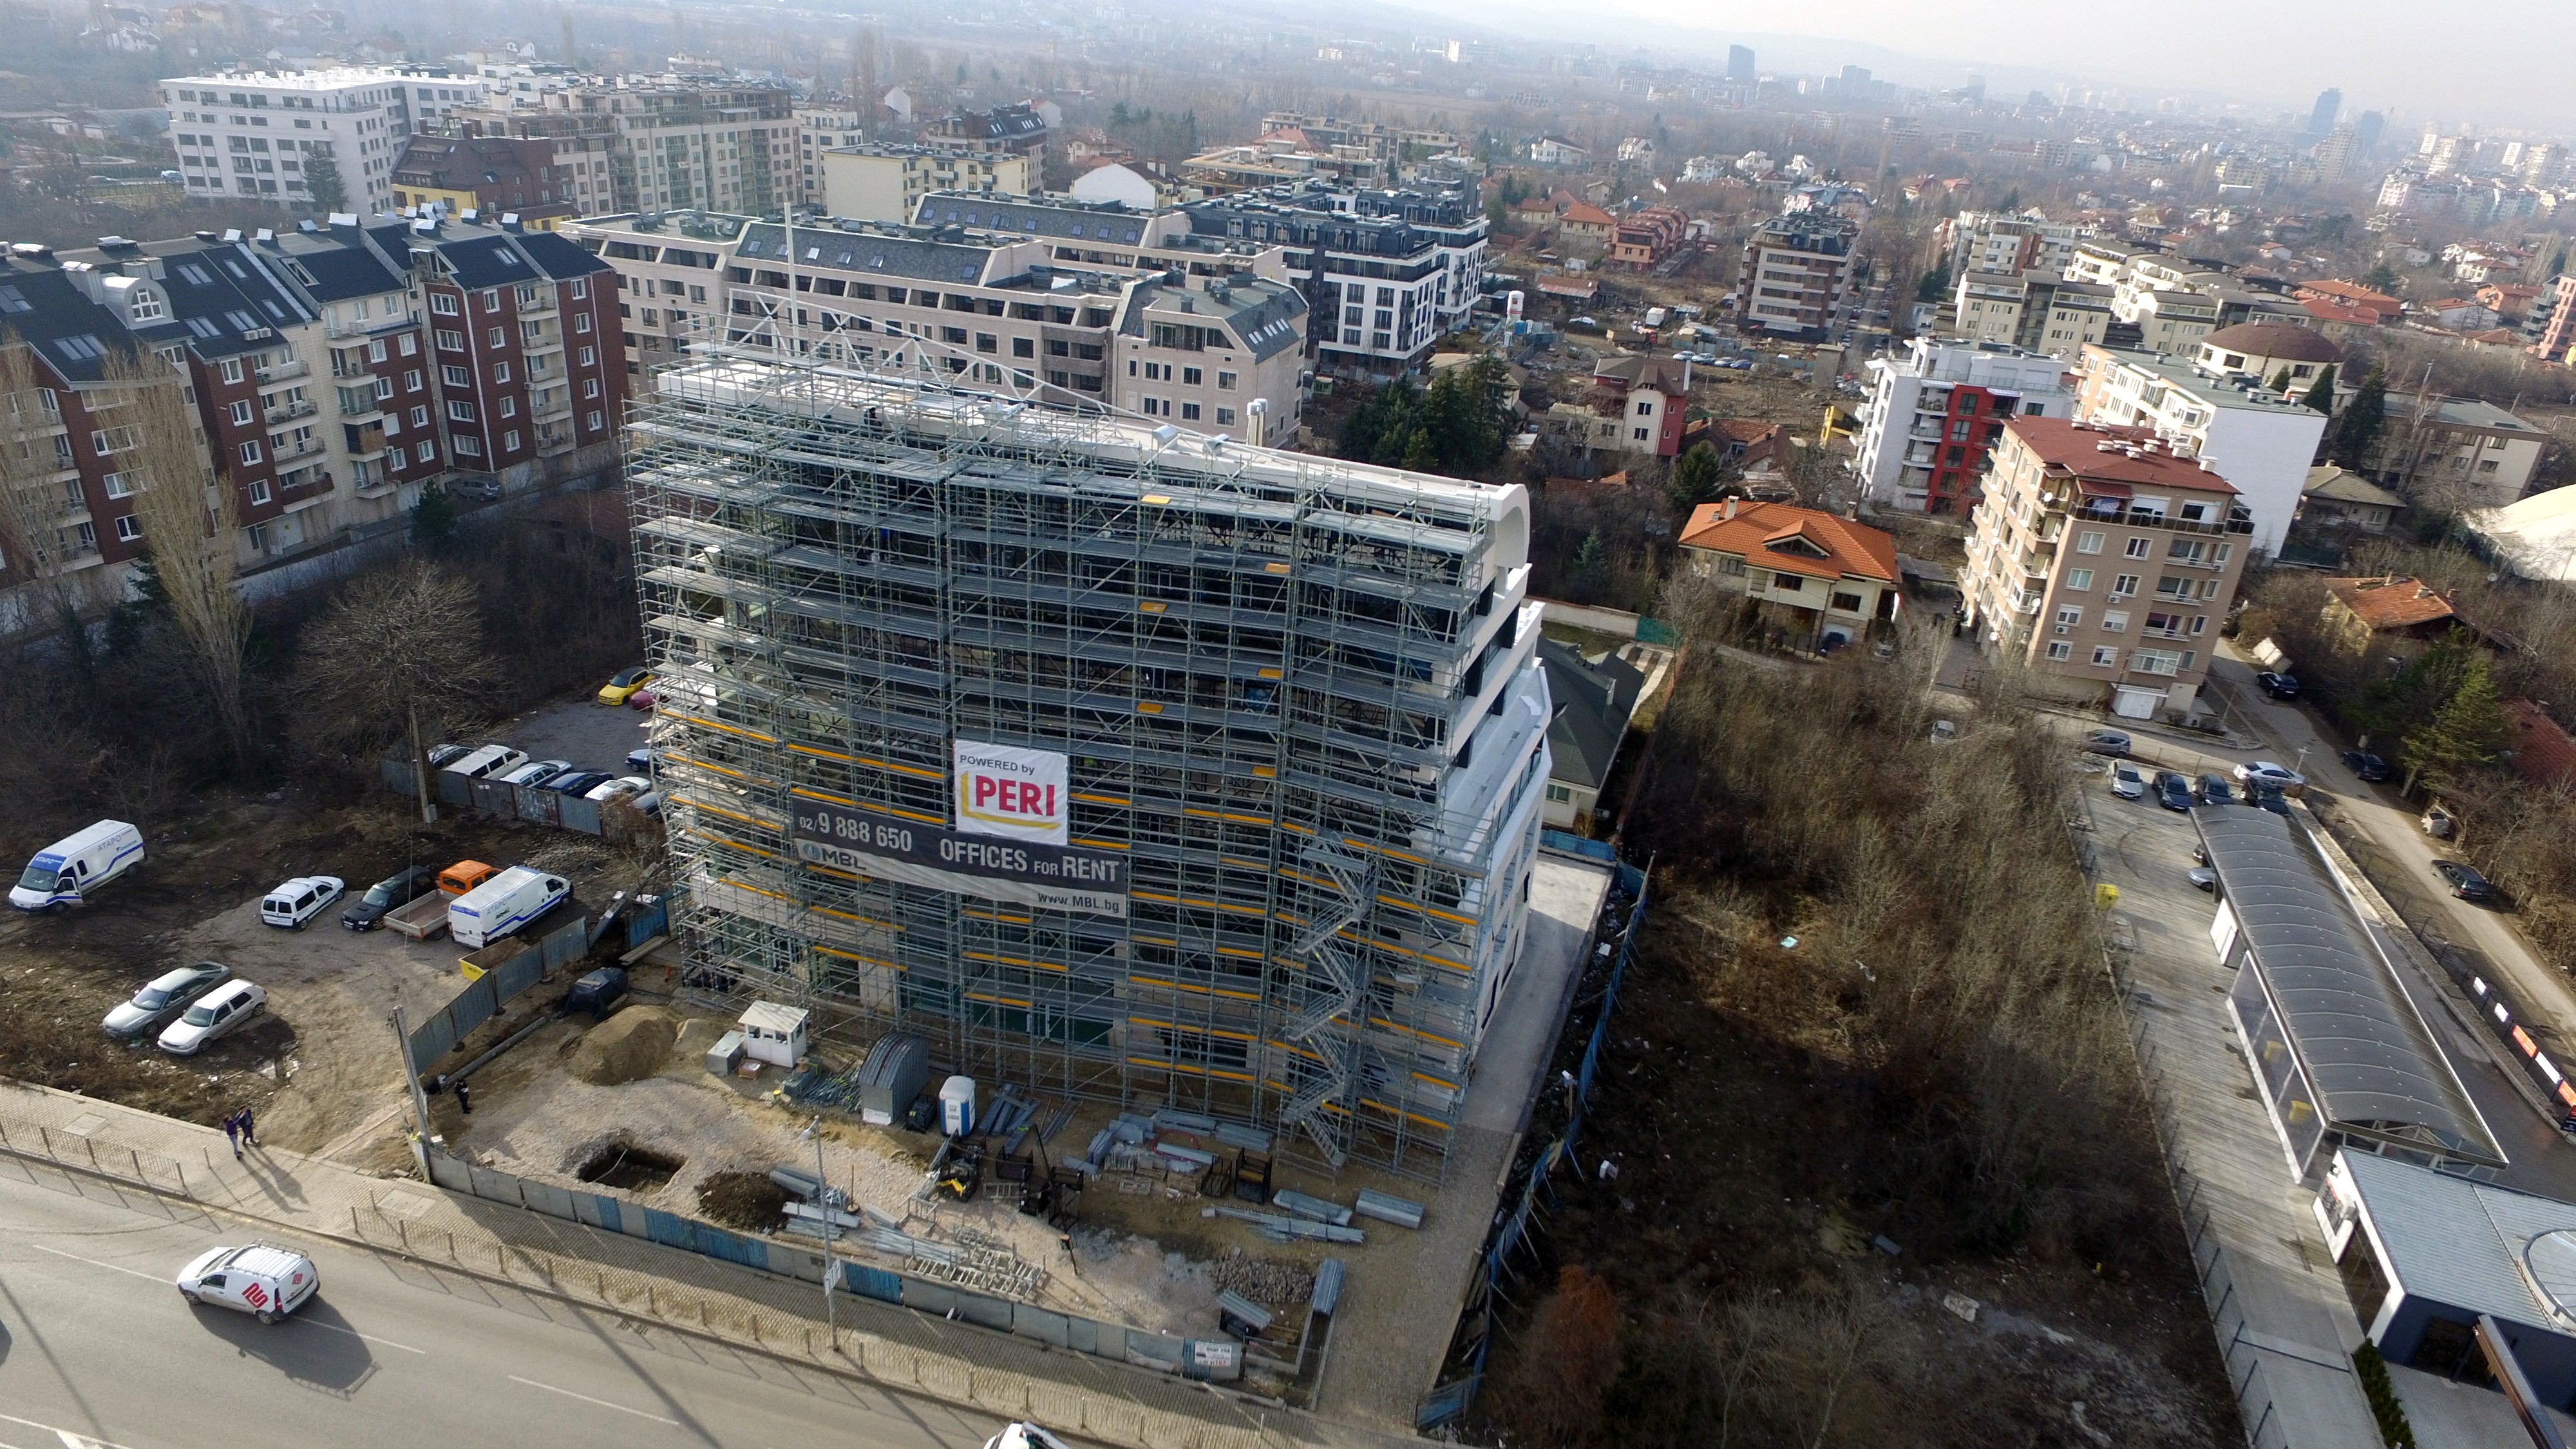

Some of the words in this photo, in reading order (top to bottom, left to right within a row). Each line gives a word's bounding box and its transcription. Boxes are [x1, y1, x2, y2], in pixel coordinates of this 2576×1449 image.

[960, 754, 1018, 772] POWERED
[1021, 764, 1035, 775] by
[976, 775, 1055, 817] PERI
[836, 816, 870, 843] 888
[876, 825, 913, 852] 650
[822, 848, 867, 871] MBL
[940, 838, 1028, 872] OFFICES
[1034, 860, 1059, 876] FOR
[1063, 856, 1119, 882] RENT
[1037, 893, 1119, 914] www.MBL.bg
